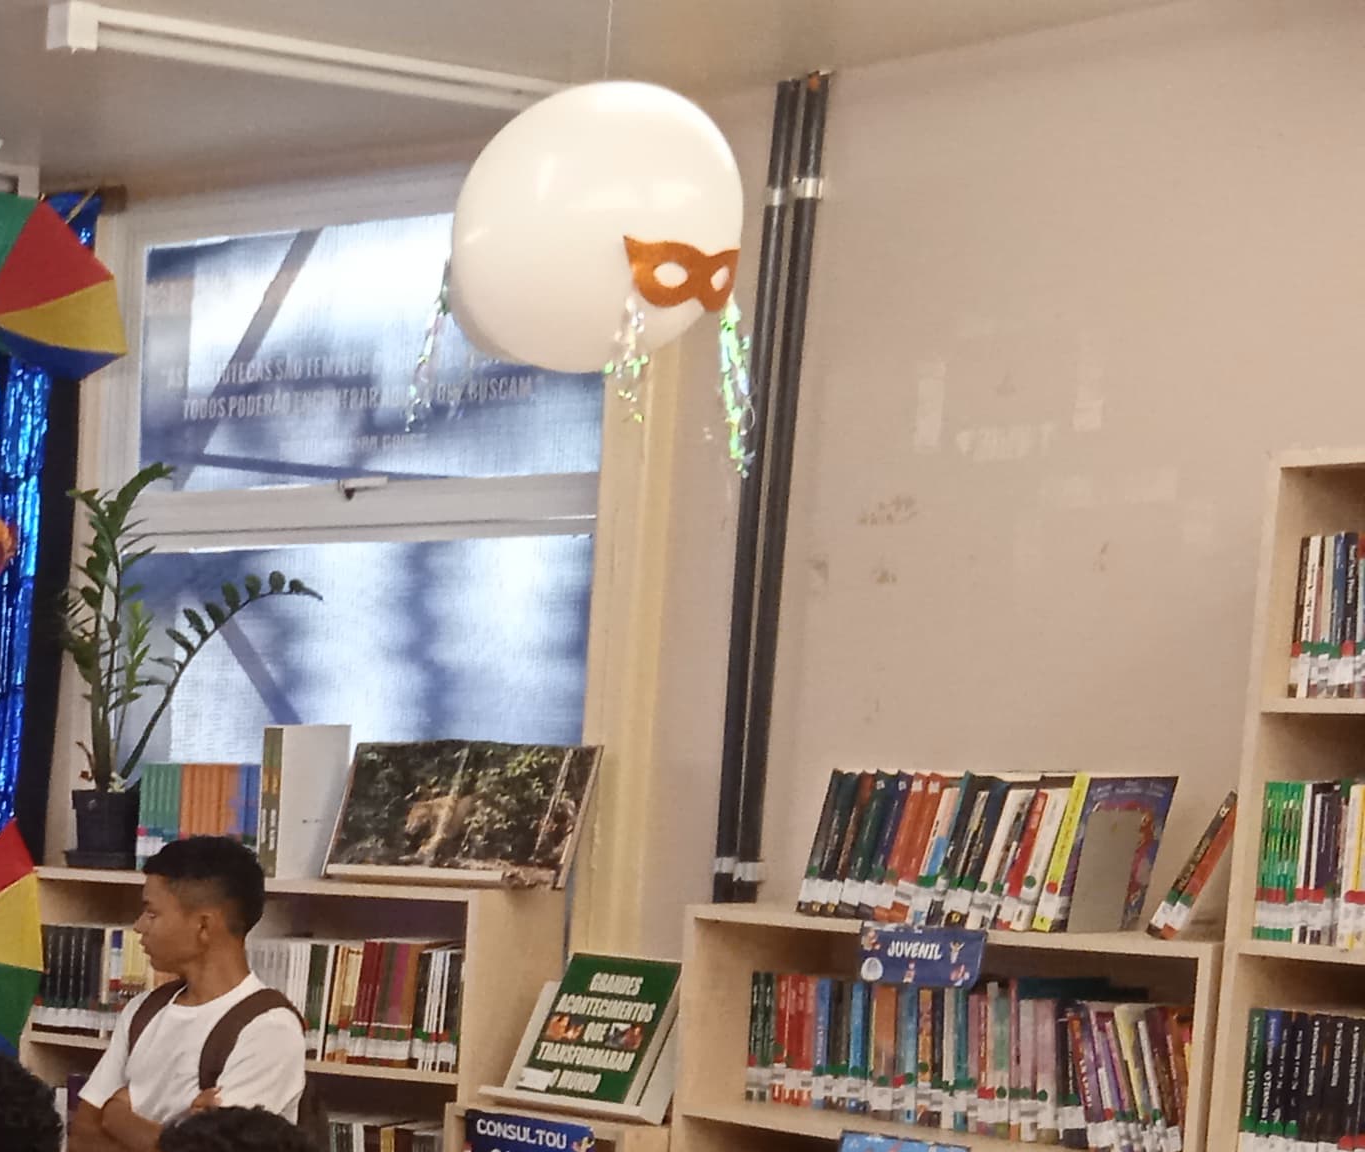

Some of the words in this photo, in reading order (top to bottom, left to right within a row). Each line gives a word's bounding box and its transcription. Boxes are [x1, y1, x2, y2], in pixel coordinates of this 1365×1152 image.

[887, 940, 943, 960] JUVENIL
[588, 971, 644, 997] GRANDES
[555, 992, 657, 1023] ACONTECIMENTOS
[583, 1021, 610, 1042] QUE
[536, 1041, 636, 1072] TRANSFORMARAM
[558, 1069, 602, 1093] MUNDO
[476, 1118, 567, 1150] CONSULTOU
